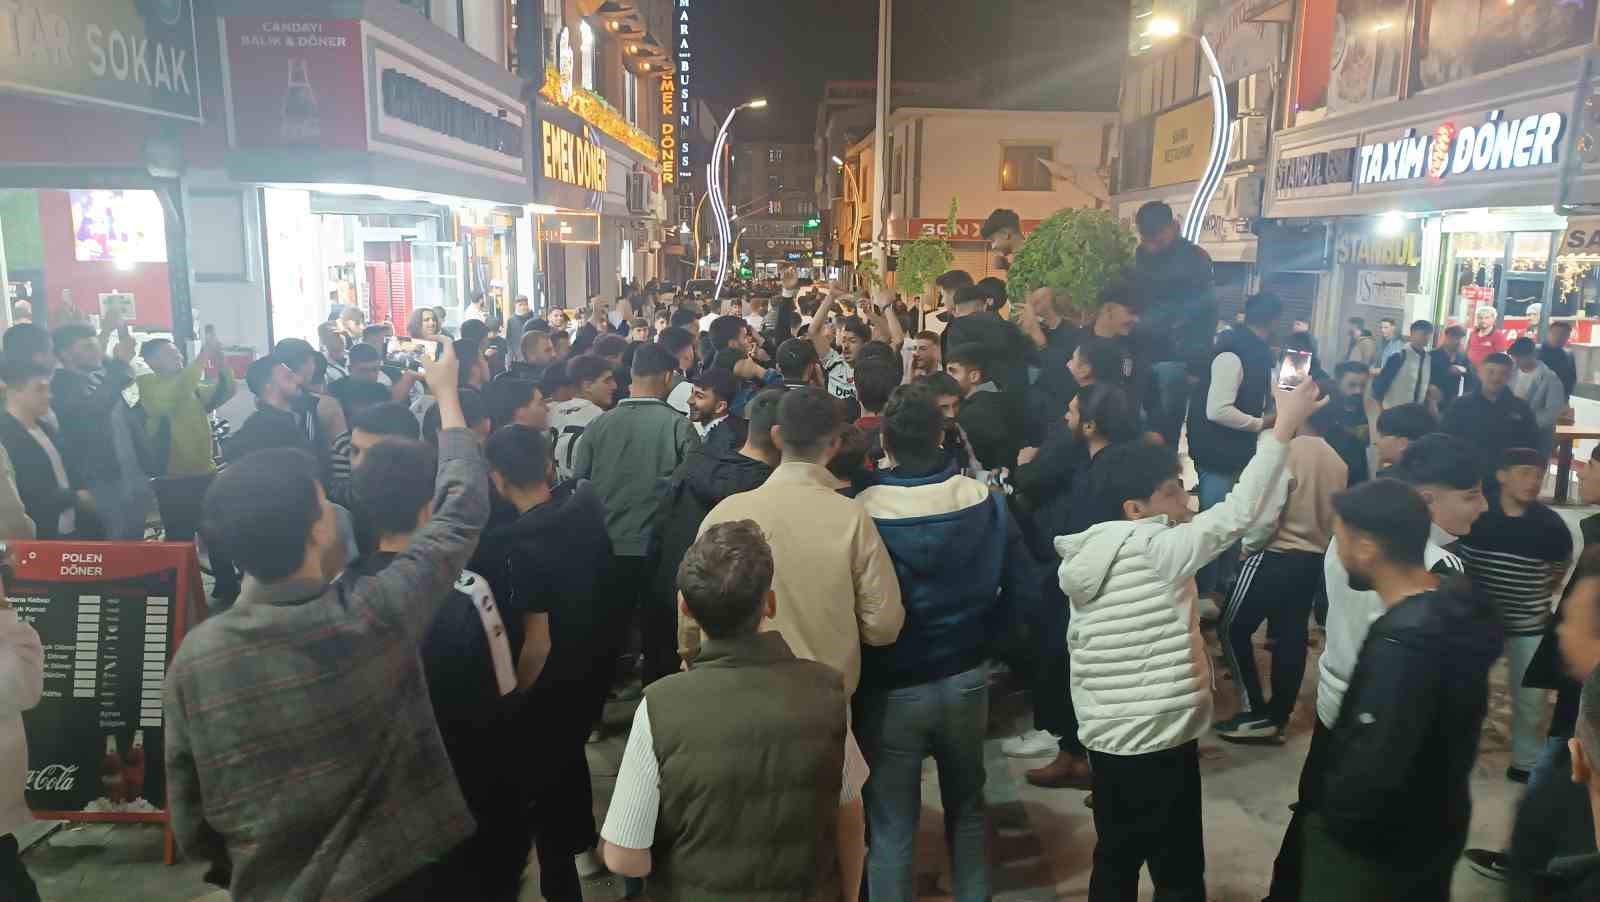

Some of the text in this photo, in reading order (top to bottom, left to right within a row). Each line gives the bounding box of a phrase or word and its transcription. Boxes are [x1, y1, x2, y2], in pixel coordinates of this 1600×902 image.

[87, 23, 191, 96] SOKAK
[297, 33, 348, 48] DÖNER
[680, 61, 690, 166] BUSINSS
[1452, 110, 1562, 174] DÖNER
[542, 120, 609, 193] EMEK DÖNER
[60, 566, 103, 576] DÖNER
[62, 553, 103, 563] POLEN
